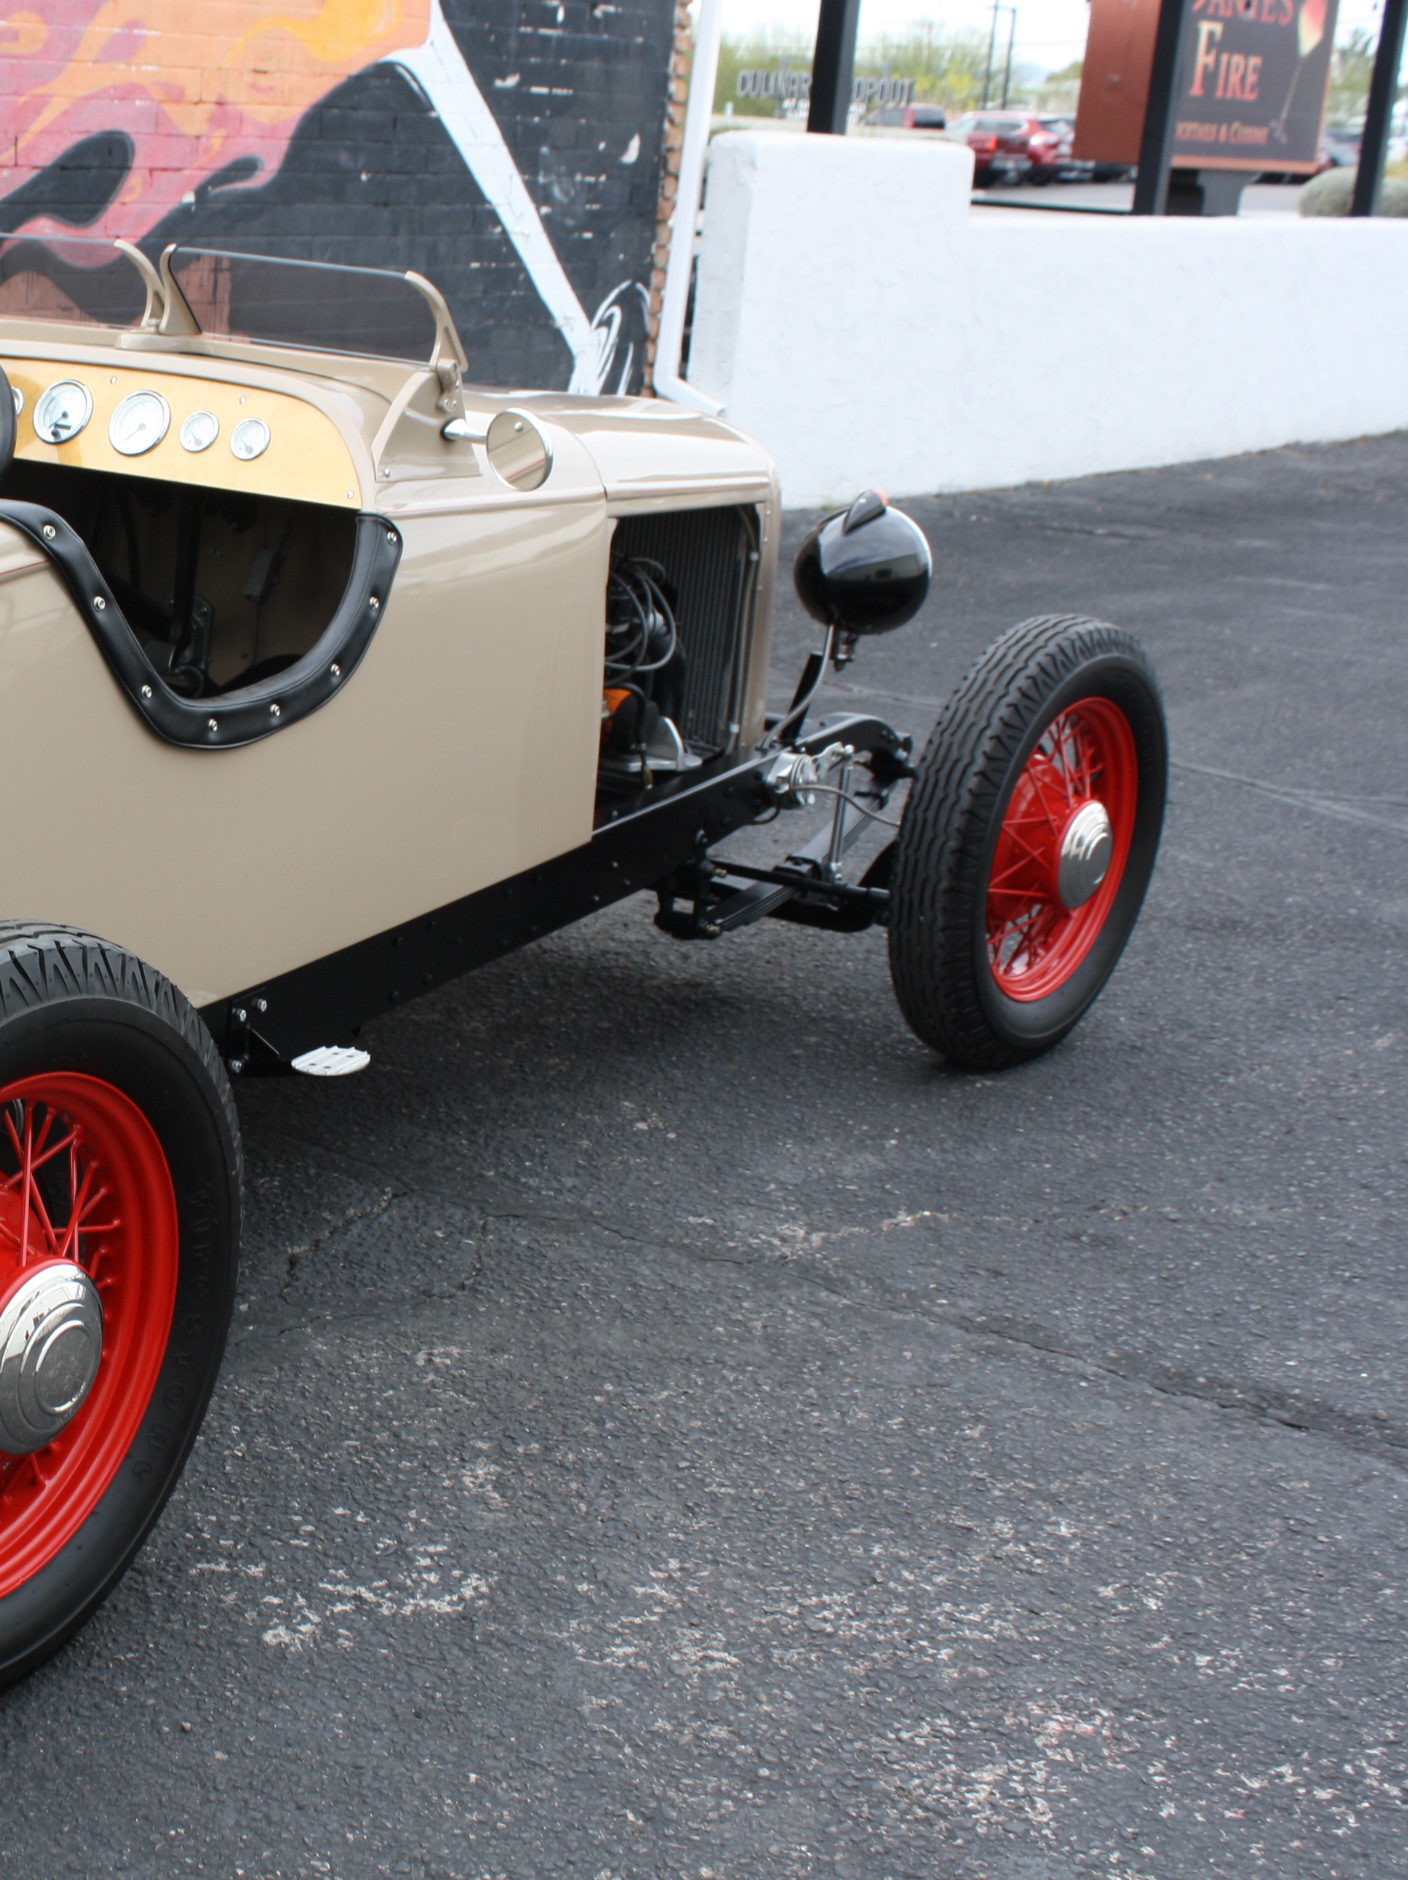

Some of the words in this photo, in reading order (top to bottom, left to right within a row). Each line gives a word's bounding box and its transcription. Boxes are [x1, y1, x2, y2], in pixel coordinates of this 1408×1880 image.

[736, 70, 812, 99] CULINAR
[1189, 20, 1263, 101] FIRE
[132, 1182, 218, 1482] Firestone
